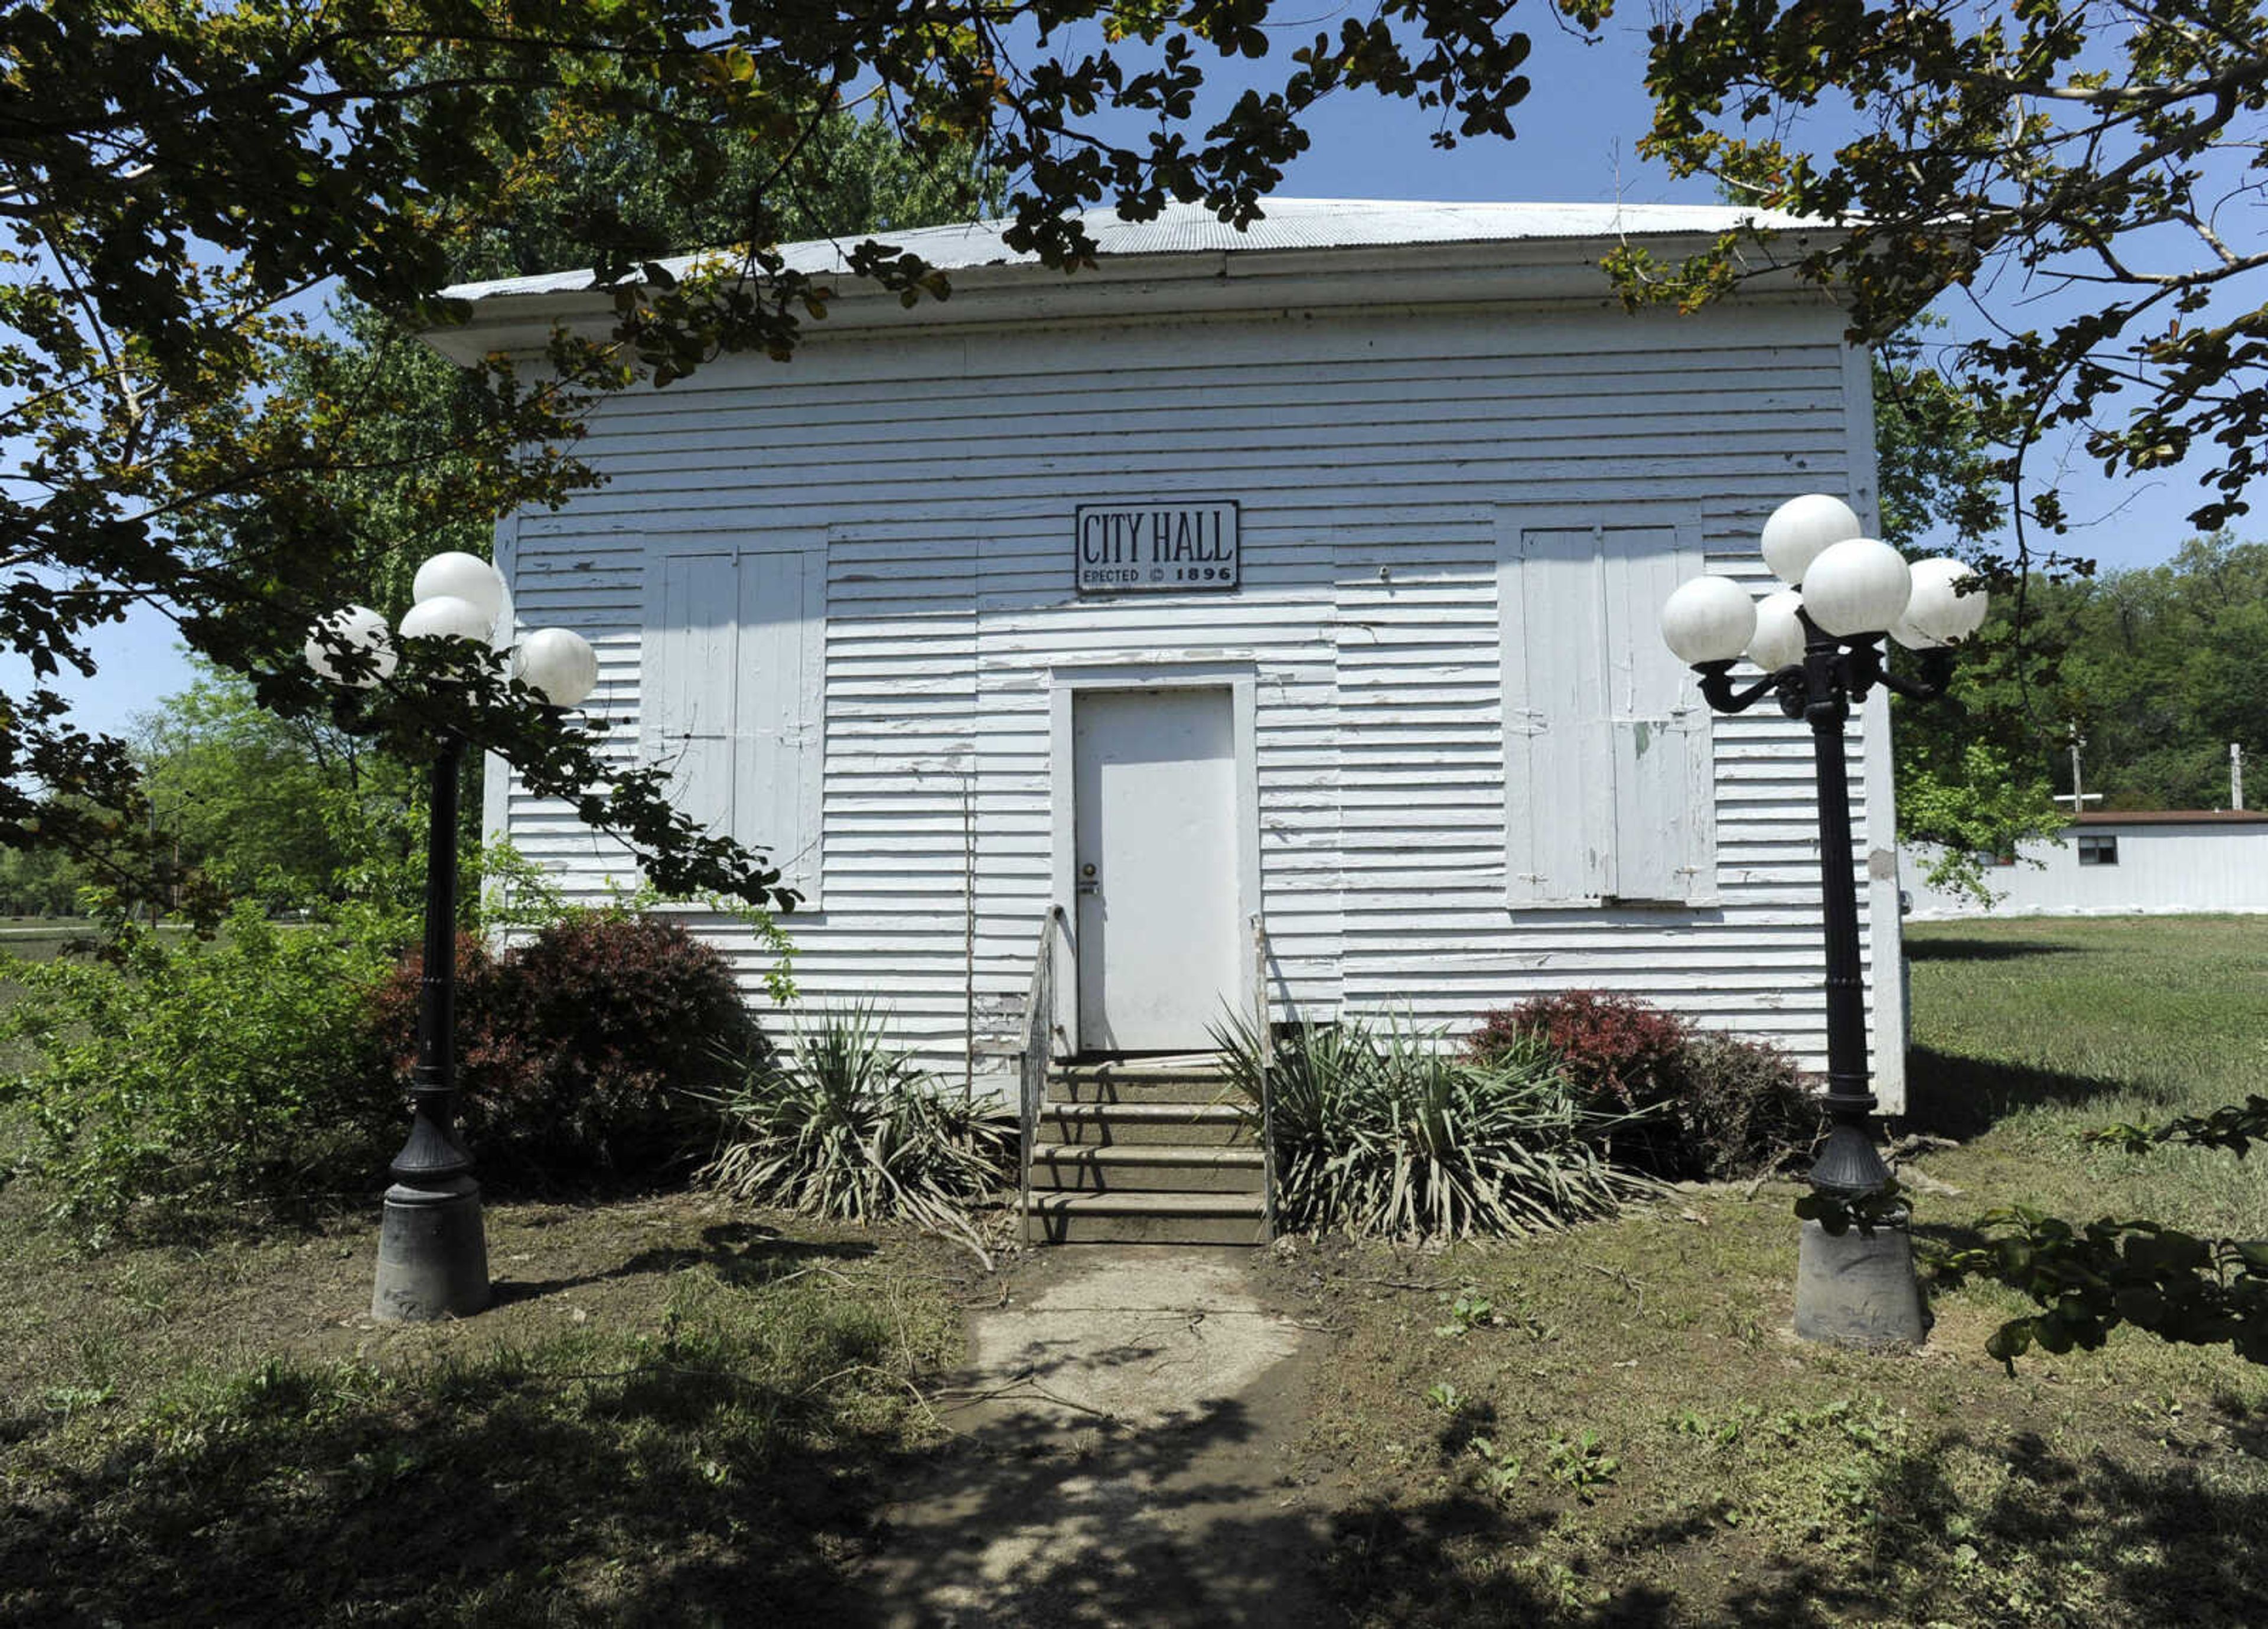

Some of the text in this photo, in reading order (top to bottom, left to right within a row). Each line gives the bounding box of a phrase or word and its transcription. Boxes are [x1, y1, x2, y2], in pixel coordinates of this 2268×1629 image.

[1084, 511, 1233, 563] CITY HALL
[1084, 569, 1139, 582] ERECTED
[1177, 568, 1231, 580] 1896
